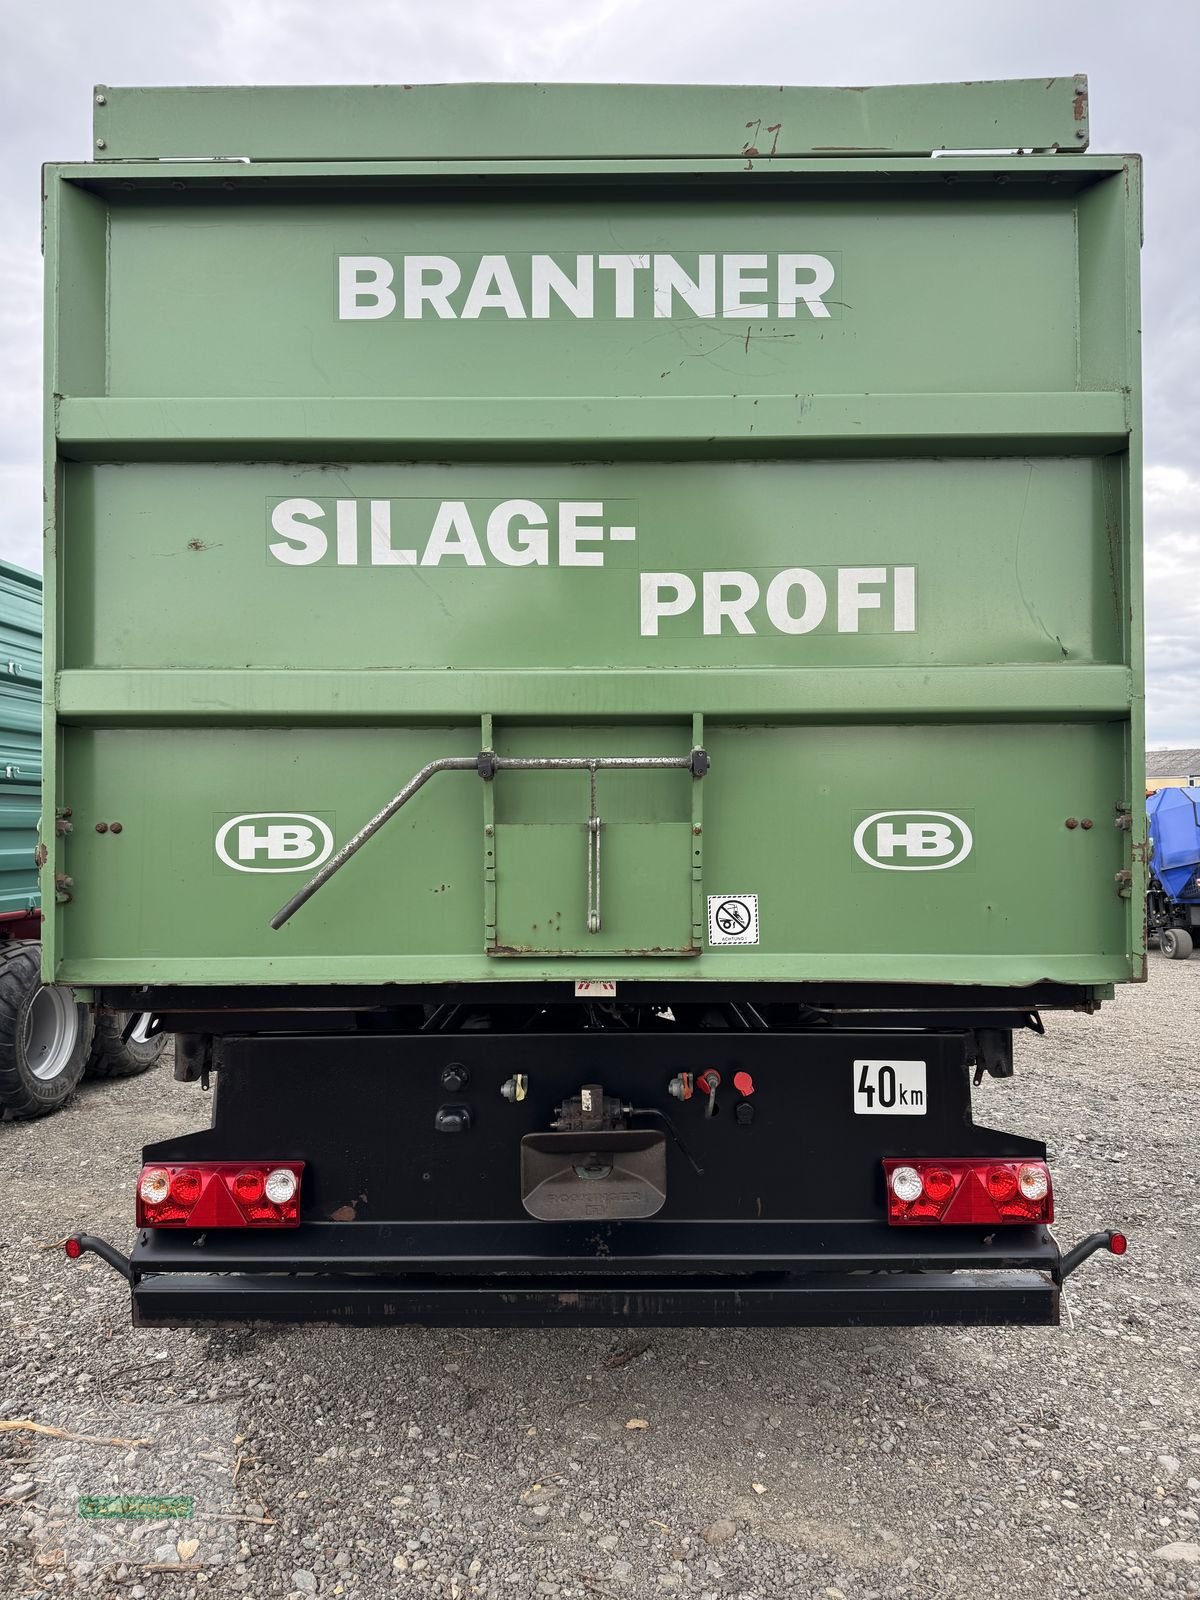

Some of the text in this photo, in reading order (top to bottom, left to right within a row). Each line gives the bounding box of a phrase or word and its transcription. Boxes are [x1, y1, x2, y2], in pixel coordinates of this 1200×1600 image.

[338, 254, 836, 320] BRANTNER
[268, 498, 637, 567] SILAGE-
[640, 566, 916, 636] PROFI
[238, 825, 316, 860] HB
[877, 823, 955, 857] HB
[858, 1065, 923, 1108] 40 km
